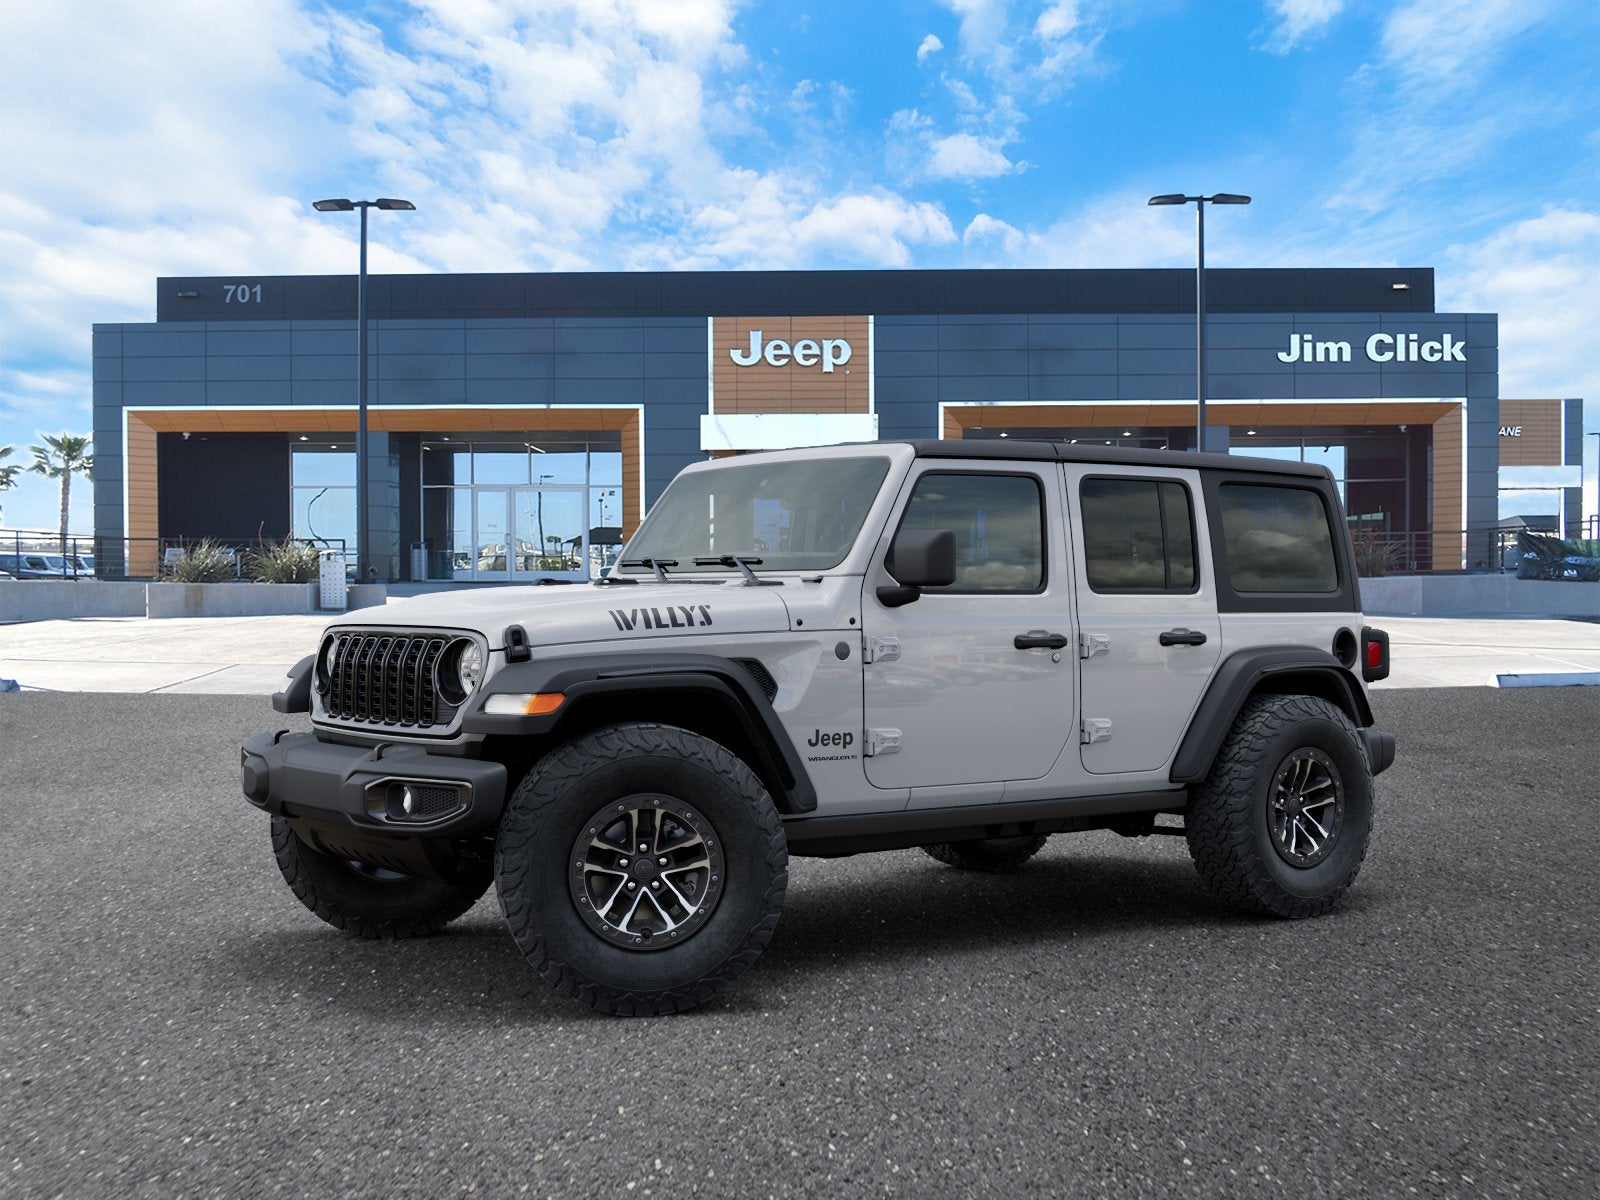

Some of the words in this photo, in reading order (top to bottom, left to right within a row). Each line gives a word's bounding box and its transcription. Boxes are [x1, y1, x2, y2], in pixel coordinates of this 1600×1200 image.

[223, 284, 262, 304] 701
[729, 330, 852, 373] Jeep
[1277, 333, 1352, 363] Jim
[1365, 333, 1467, 363] Click
[608, 604, 713, 631] WILLYS
[807, 729, 854, 749] Jeep
